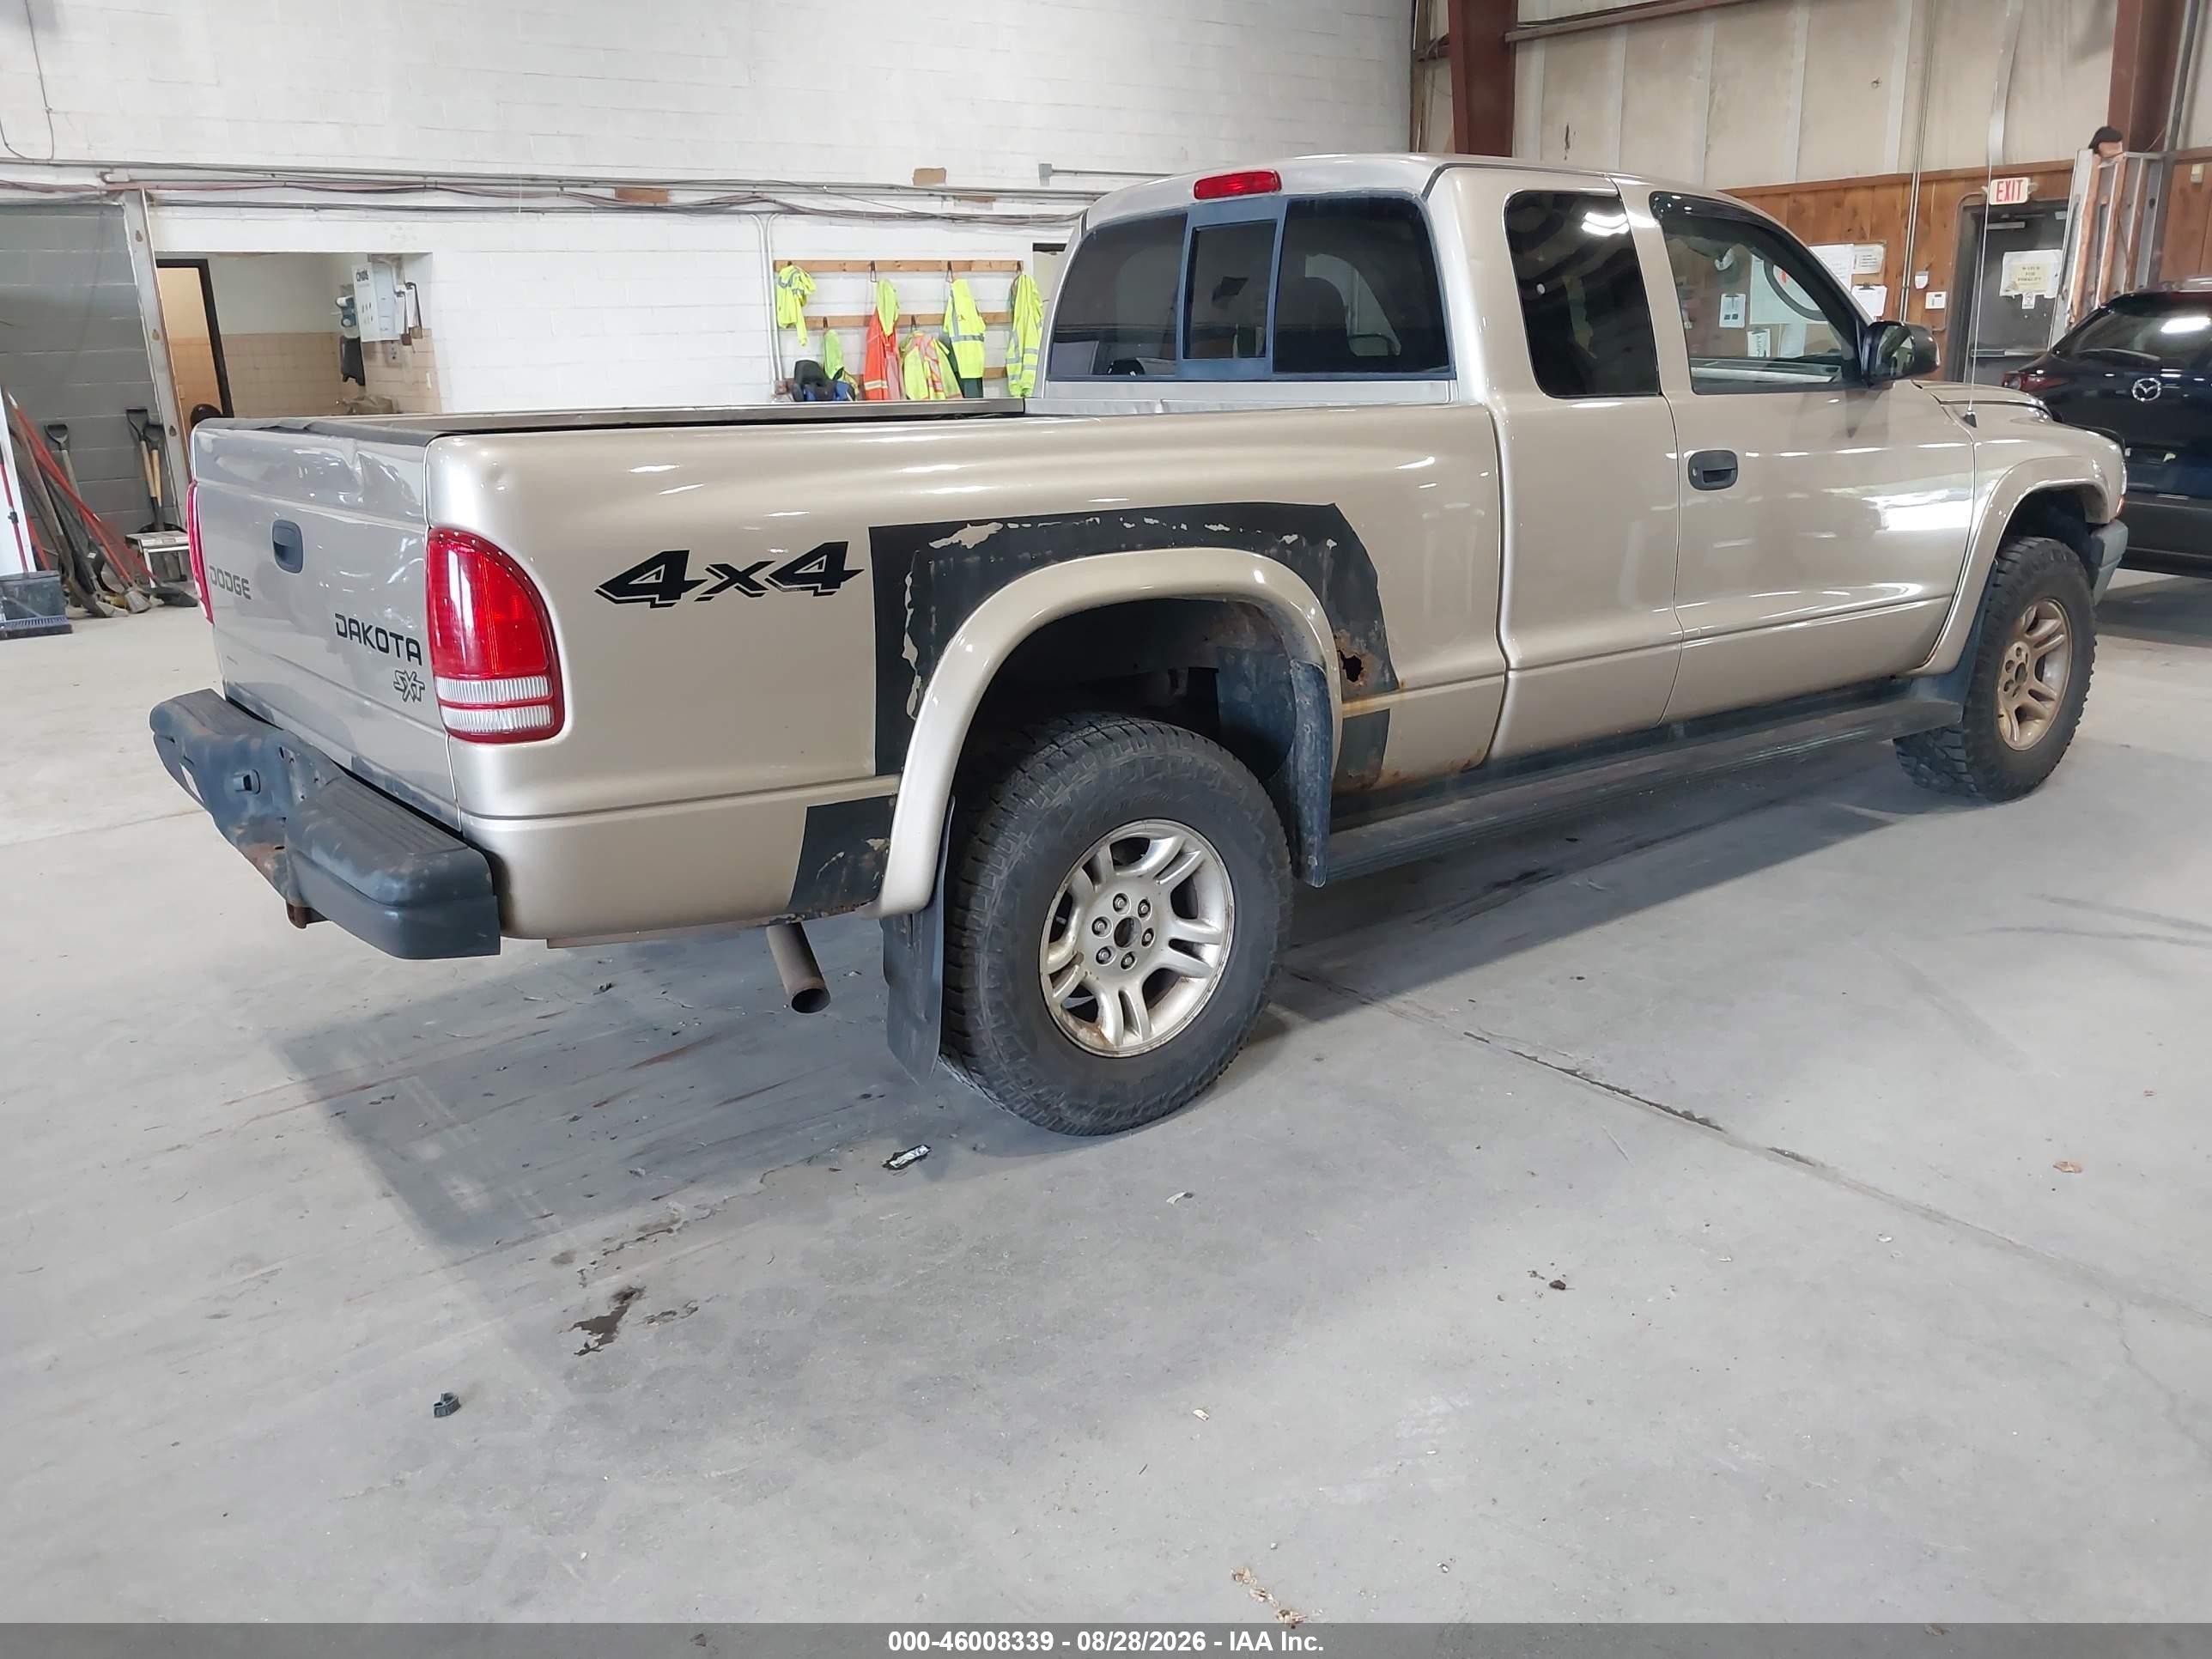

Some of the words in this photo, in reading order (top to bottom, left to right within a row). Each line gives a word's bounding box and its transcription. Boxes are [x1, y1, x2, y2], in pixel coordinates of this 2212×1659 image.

[1996, 179, 2024, 203] EXIT
[209, 565, 252, 600] DODGE
[335, 612, 423, 666] DAKOTA
[392, 670, 426, 702] SXT
